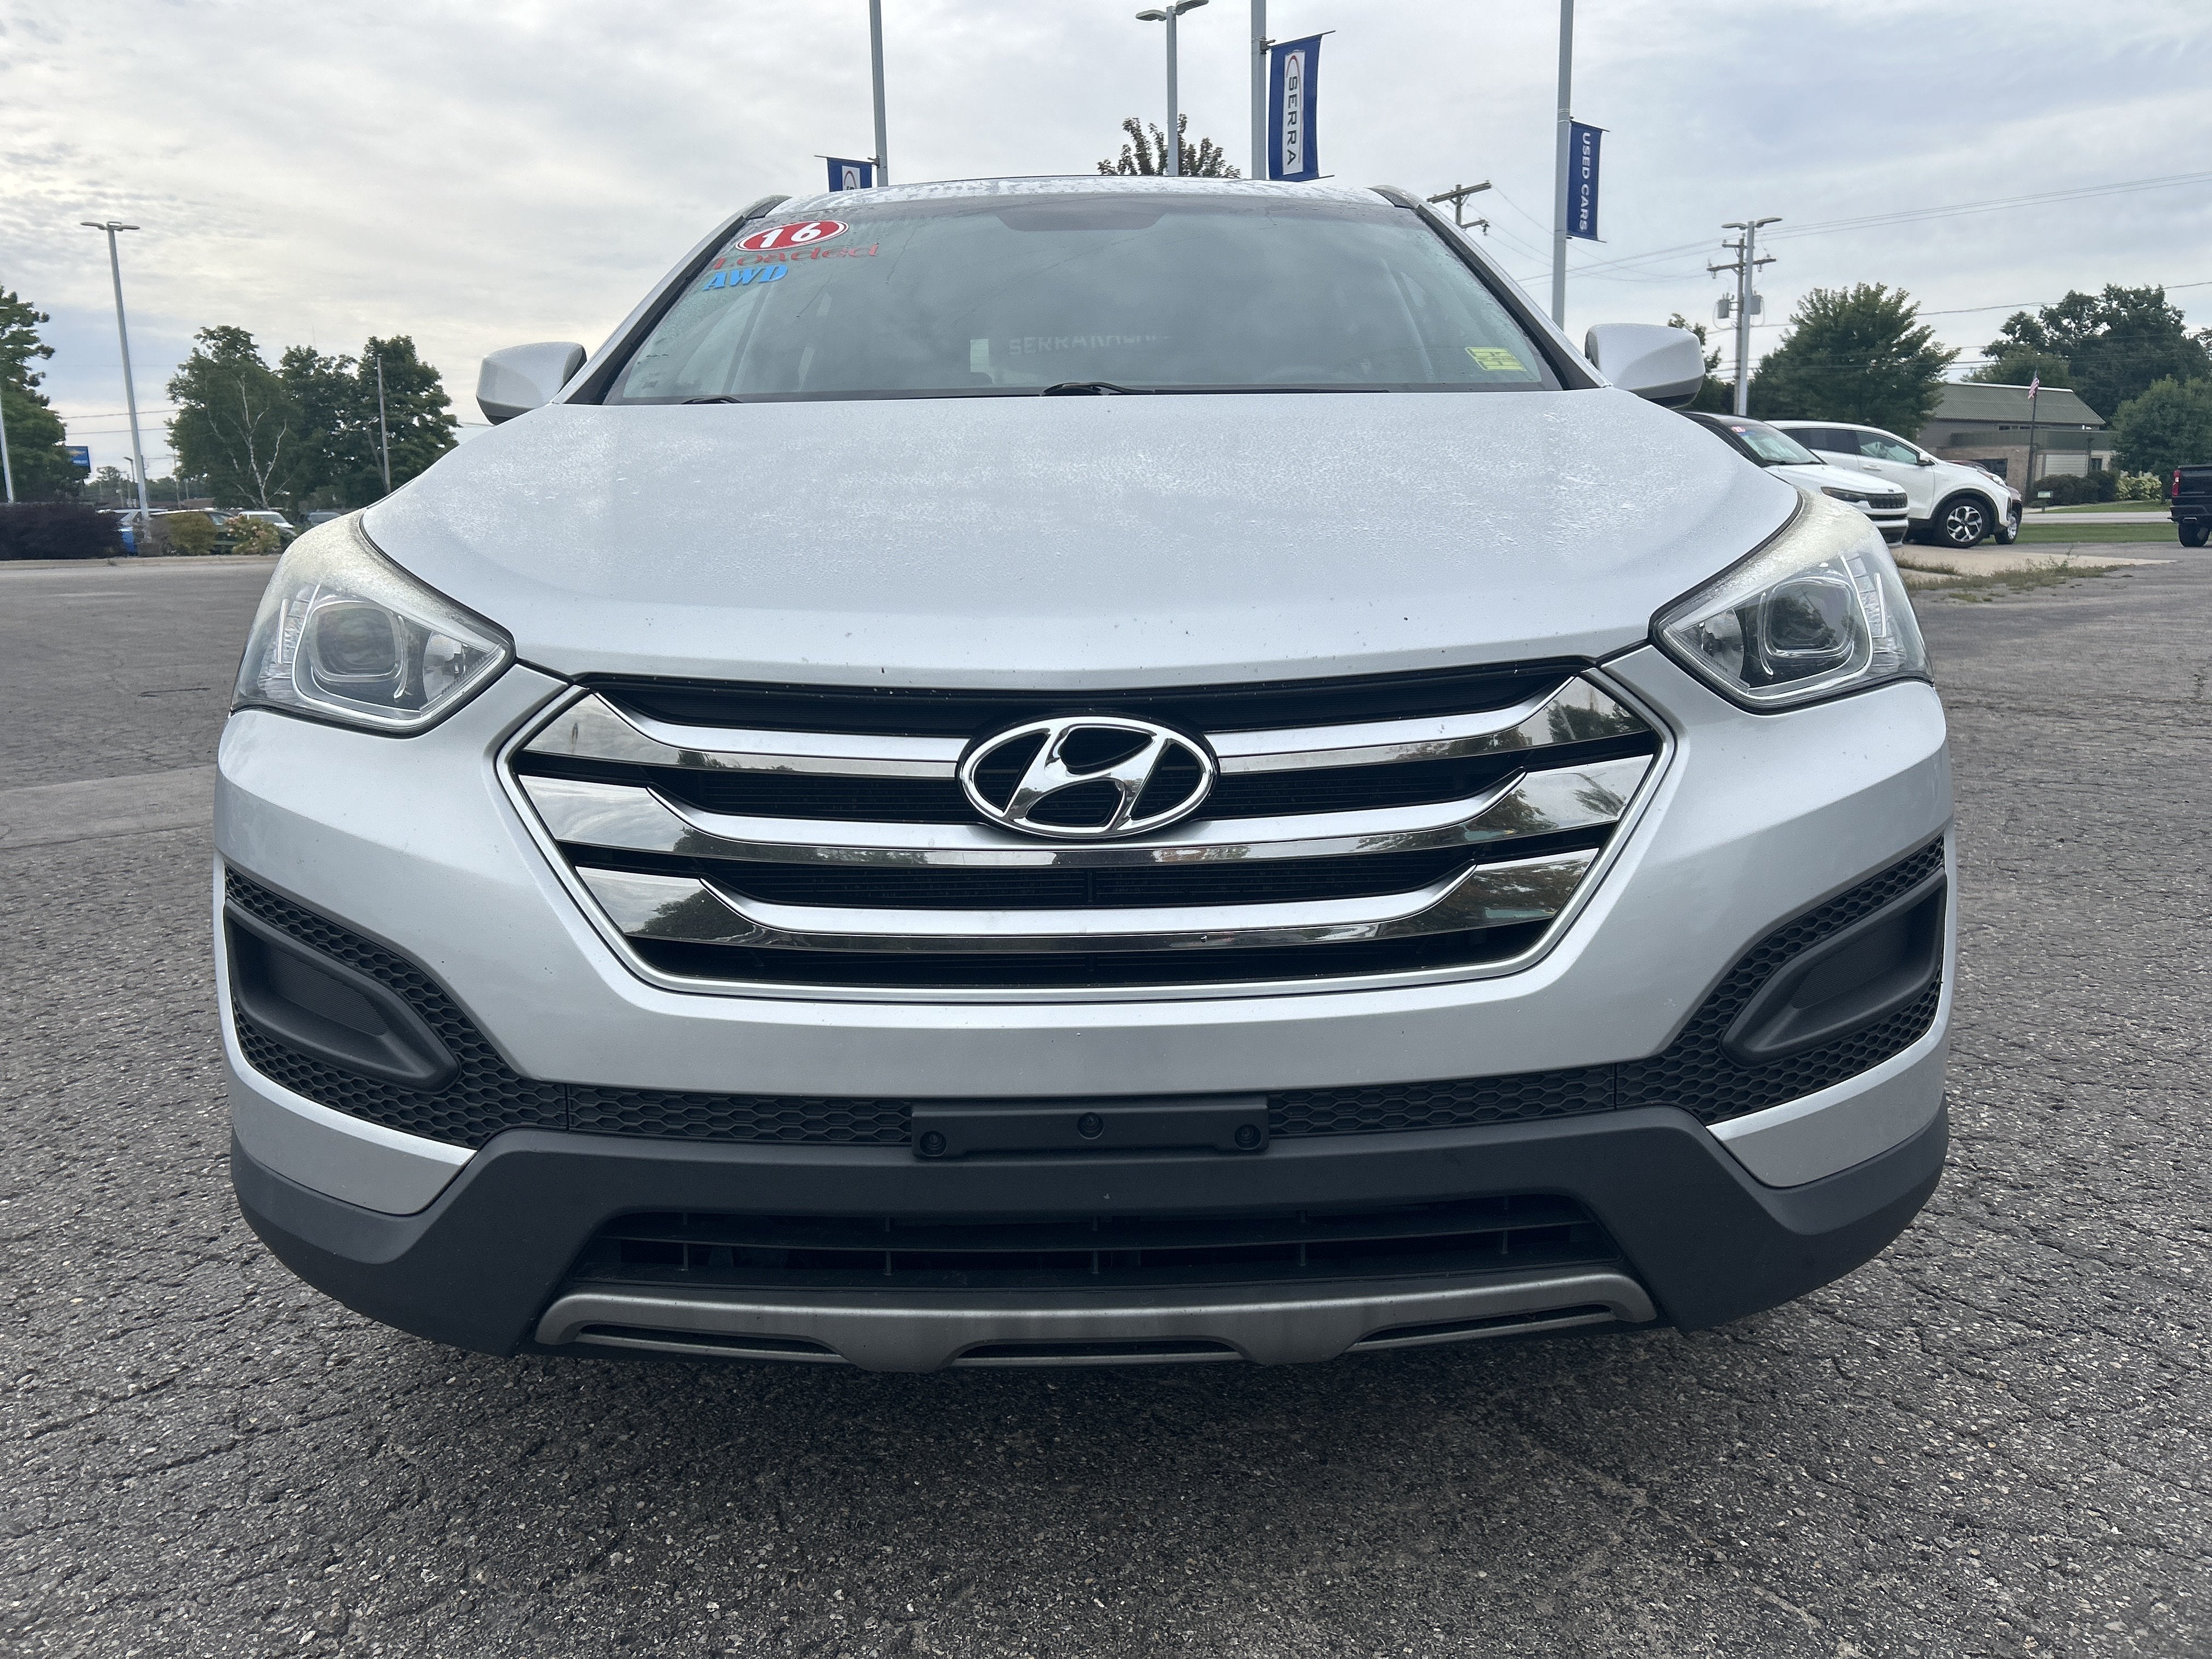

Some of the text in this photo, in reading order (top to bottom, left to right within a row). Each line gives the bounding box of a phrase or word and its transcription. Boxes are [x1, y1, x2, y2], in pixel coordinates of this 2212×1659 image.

[1287, 76, 1297, 165] SERRA
[1579, 132, 1591, 230] USED CARS
[759, 222, 822, 247] 16
[702, 264, 788, 291] AWD
